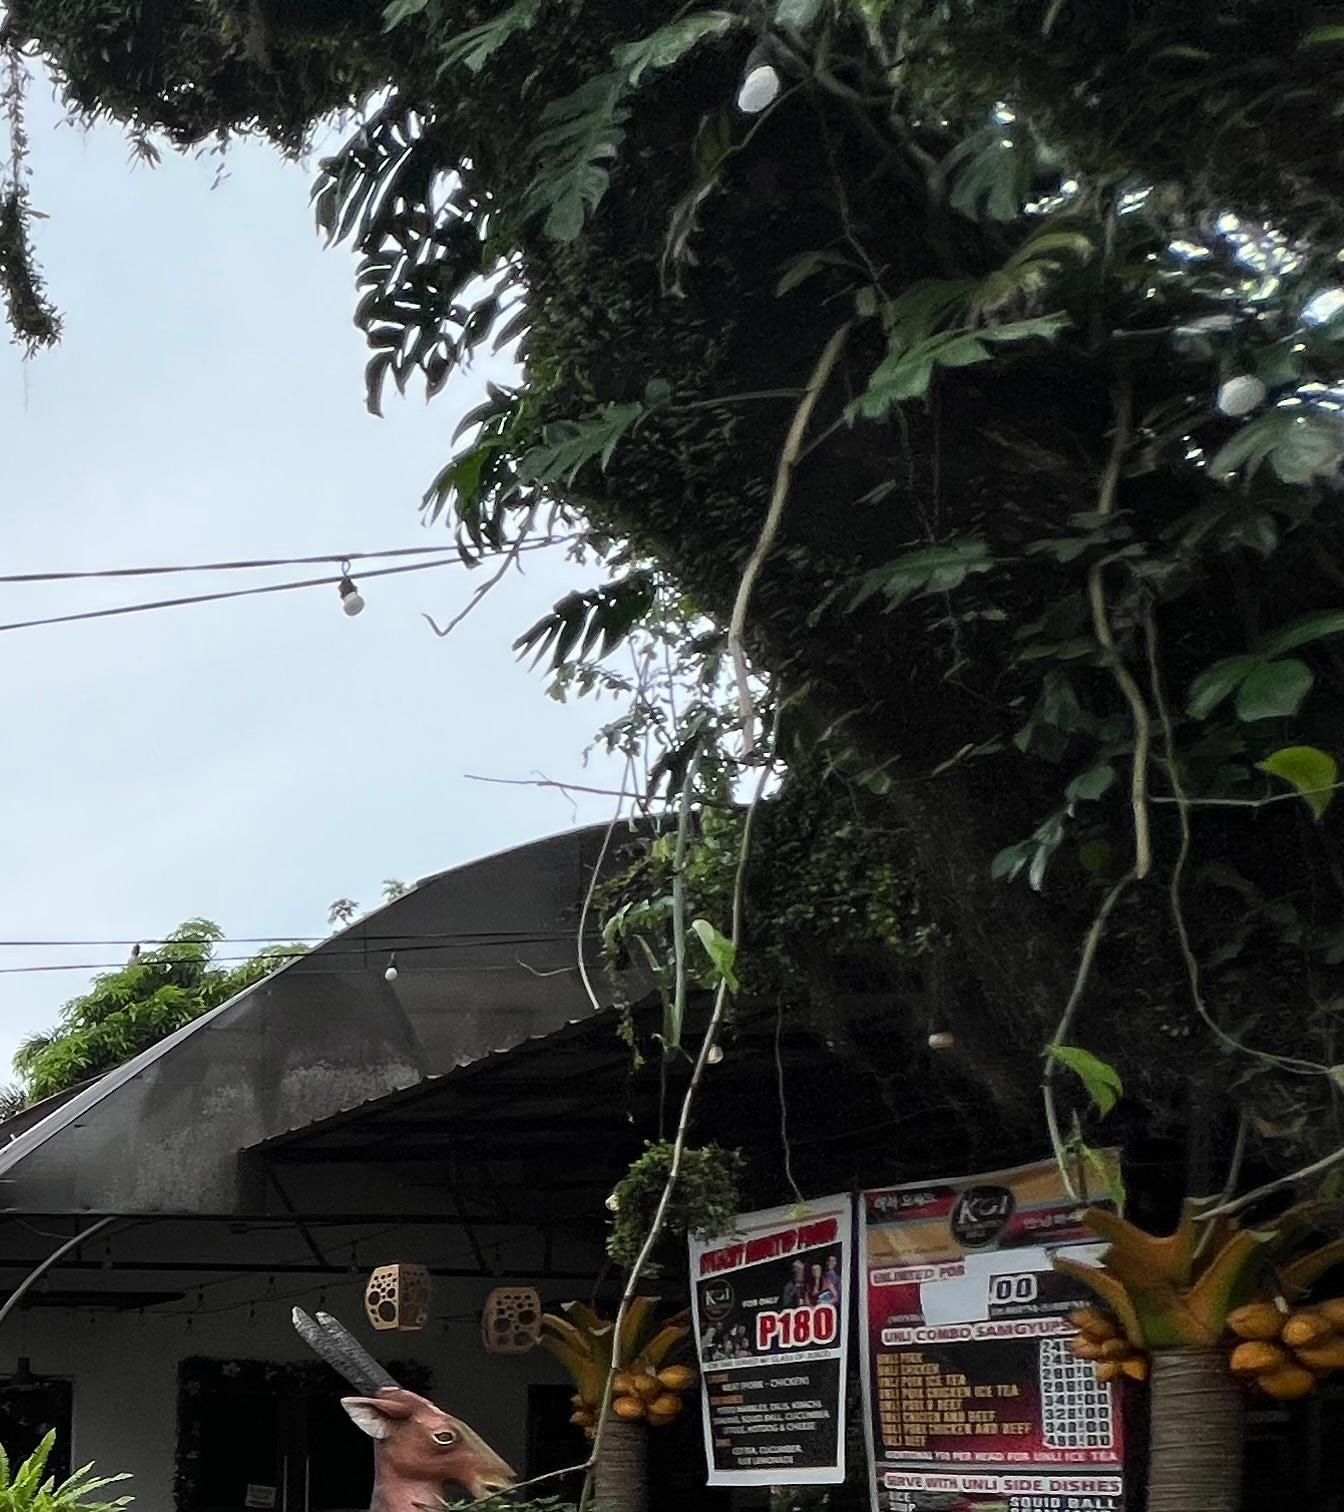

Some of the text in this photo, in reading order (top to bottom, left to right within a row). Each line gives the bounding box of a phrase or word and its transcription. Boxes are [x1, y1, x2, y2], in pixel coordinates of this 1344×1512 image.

[758, 1306, 835, 1349] P180
[916, 1325, 972, 1341] COMBO
[975, 1318, 1075, 1338] SAMGYUPS
[997, 1384, 1020, 1397] TEA
[968, 1411, 996, 1422] BEEF
[1002, 1422, 1032, 1435] BEEF
[1007, 1452, 1030, 1461] FOR
[1033, 1452, 1062, 1461] UNLI
[1065, 1452, 1086, 1461] ICE
[1090, 1451, 1119, 1461] TEA
[886, 1475, 1121, 1493] SERVE WITH UNLI SIDE DISHES
[1010, 1497, 1118, 1509] SQUID BALL
